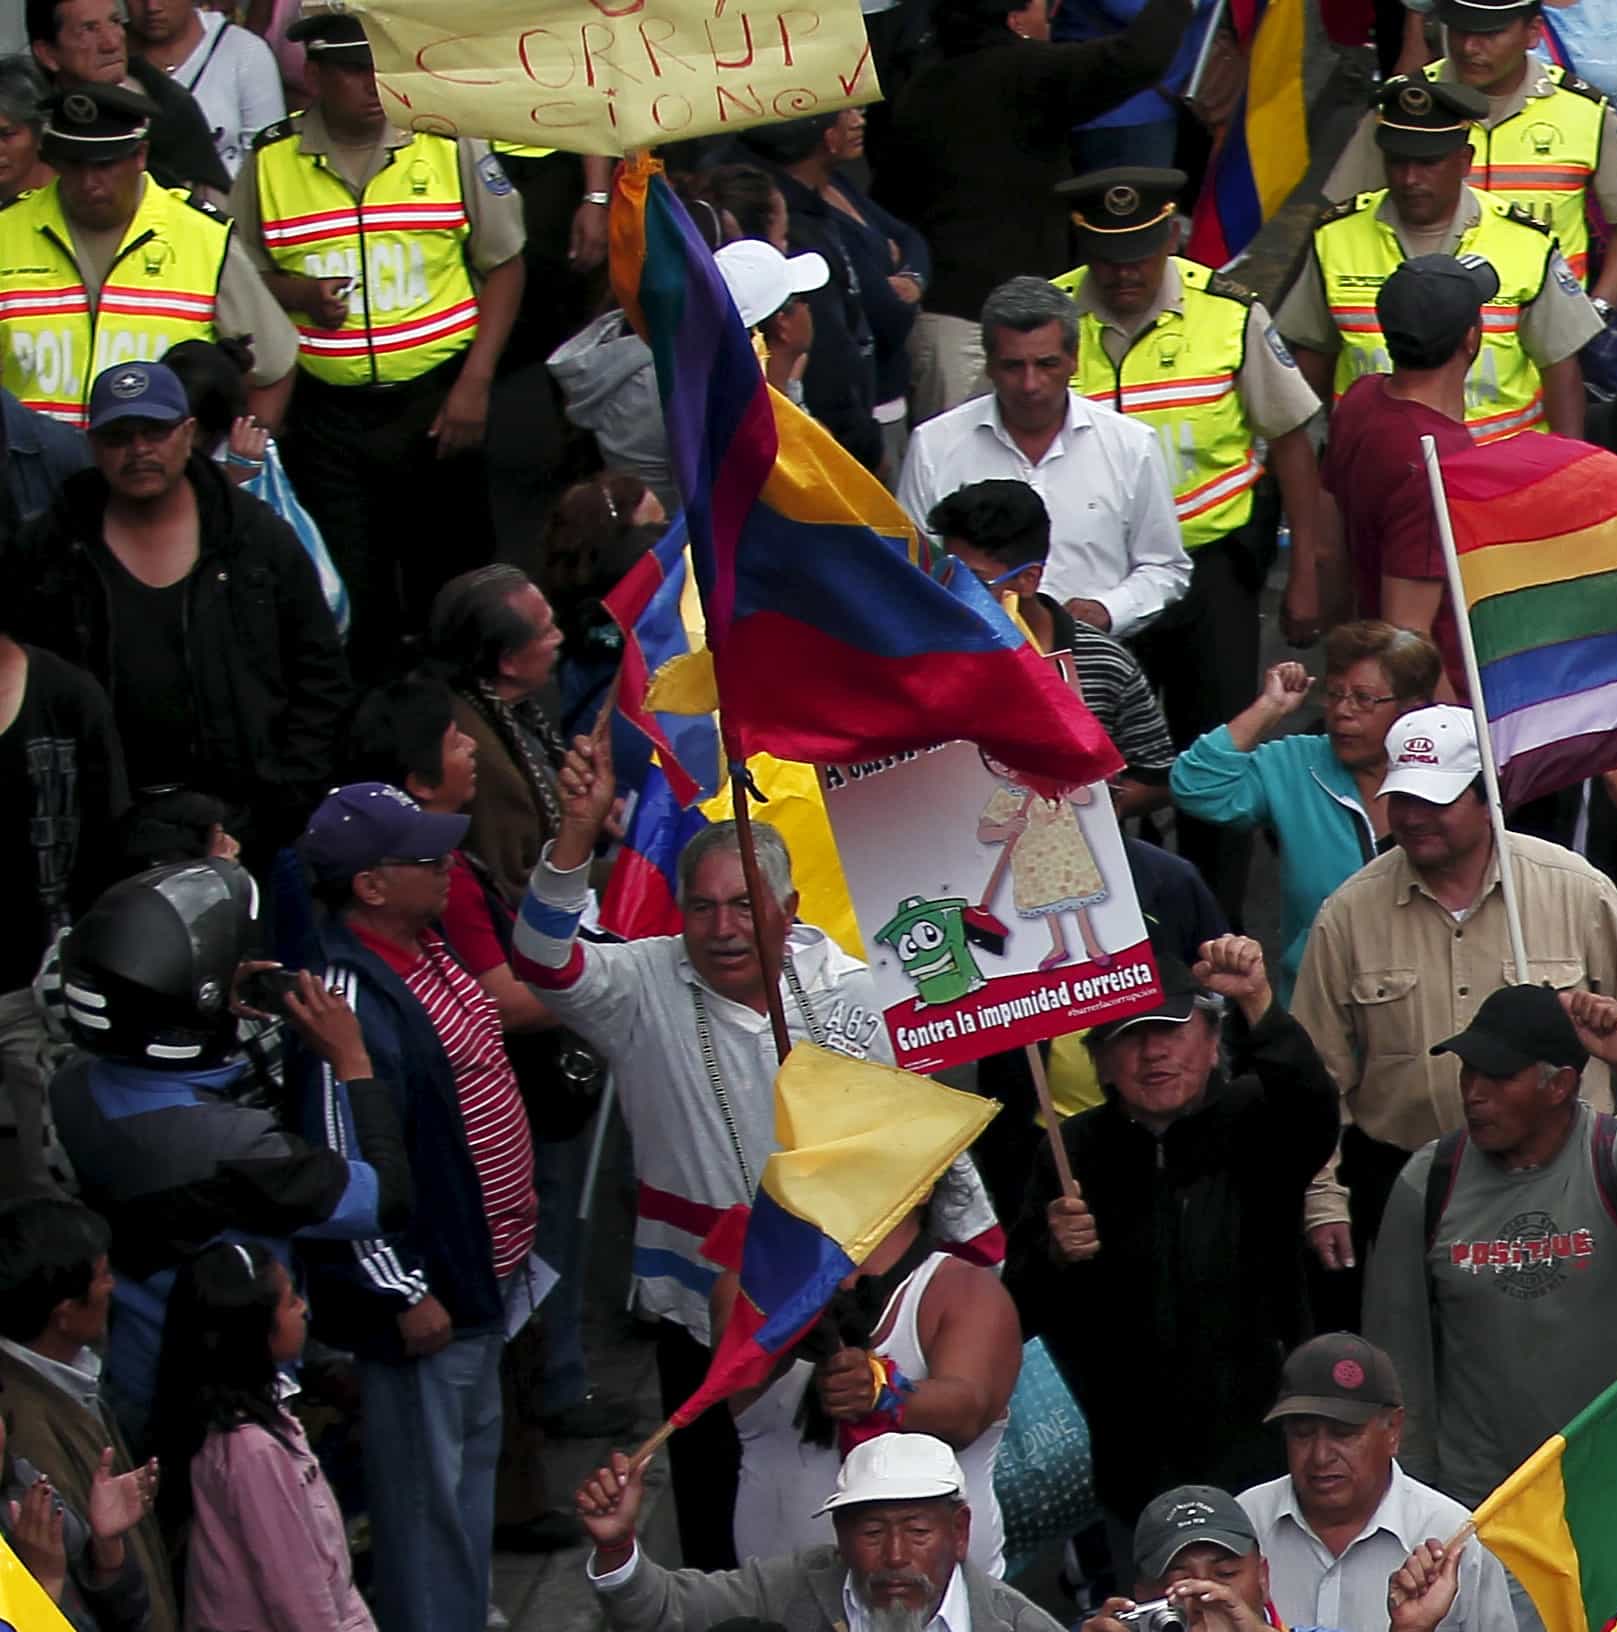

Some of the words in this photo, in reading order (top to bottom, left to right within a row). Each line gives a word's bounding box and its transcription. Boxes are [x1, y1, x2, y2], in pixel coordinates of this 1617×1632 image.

[417, 12, 820, 89] CORRUP
[1406, 739, 1431, 751] KIA
[897, 1018, 957, 1052] Contra
[959, 1010, 977, 1036] la
[979, 982, 1067, 1029] impunidad
[1073, 962, 1153, 1003] correista
